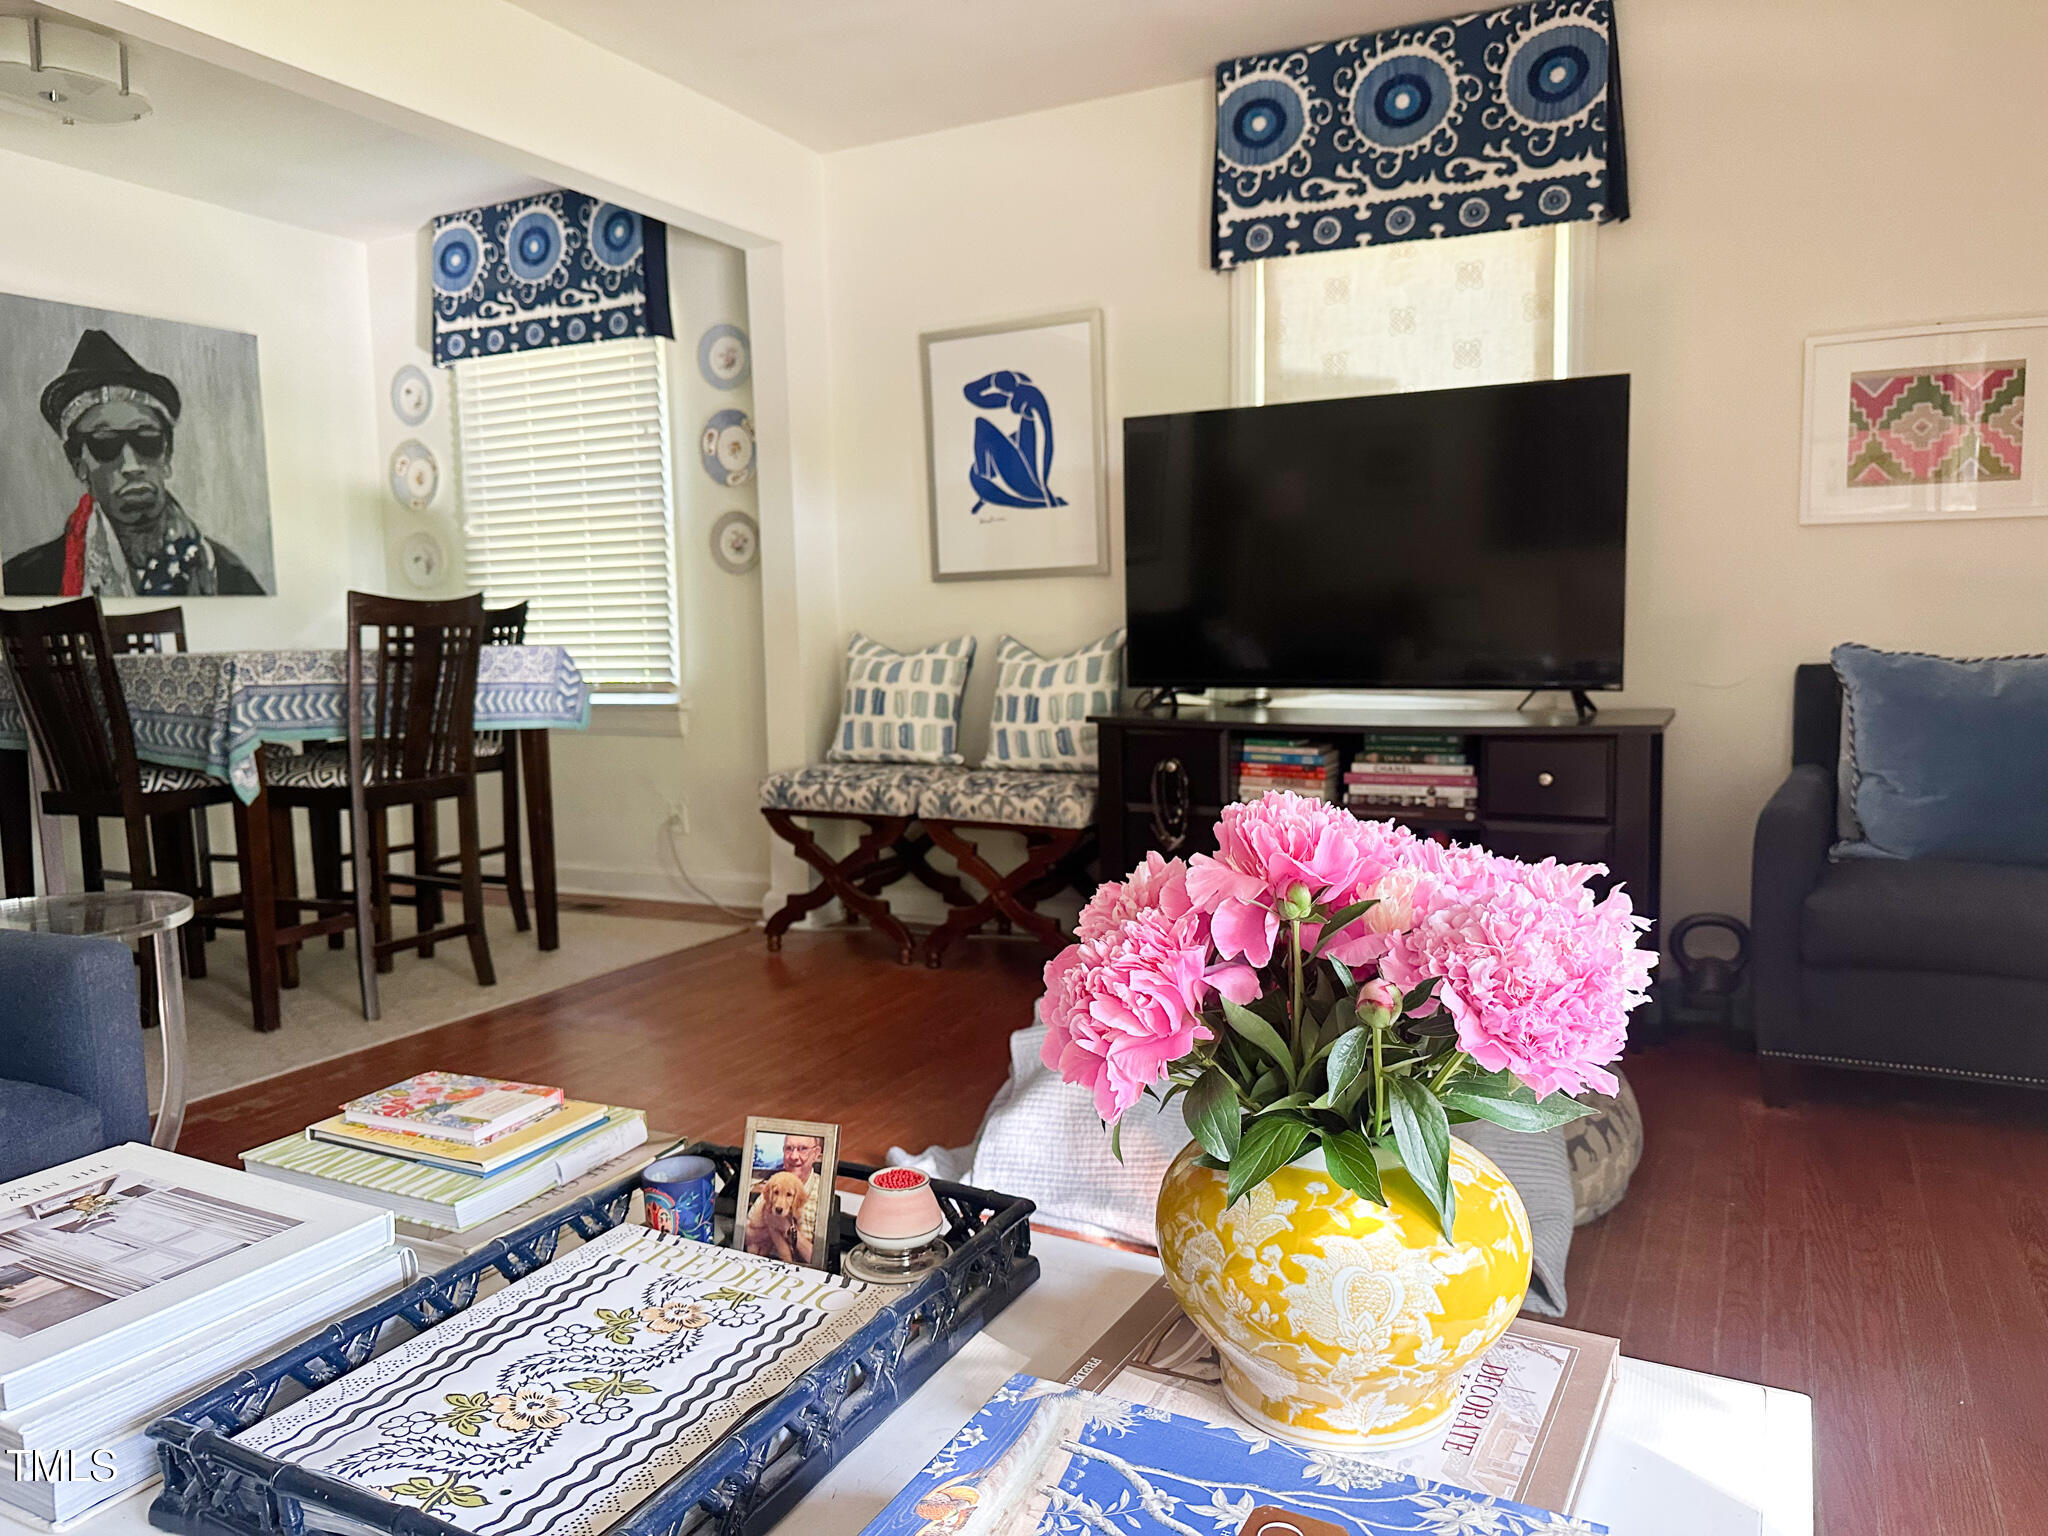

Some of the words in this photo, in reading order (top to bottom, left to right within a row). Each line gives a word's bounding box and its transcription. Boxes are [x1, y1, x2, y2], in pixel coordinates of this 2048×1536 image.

[1373, 765, 1413, 774] CHANEL
[67, 1165, 110, 1180] THE
[9, 1181, 60, 1202] NEW
[616, 1237, 861, 1312] FREDERIC
[1442, 1363, 1508, 1456] DECORATE
